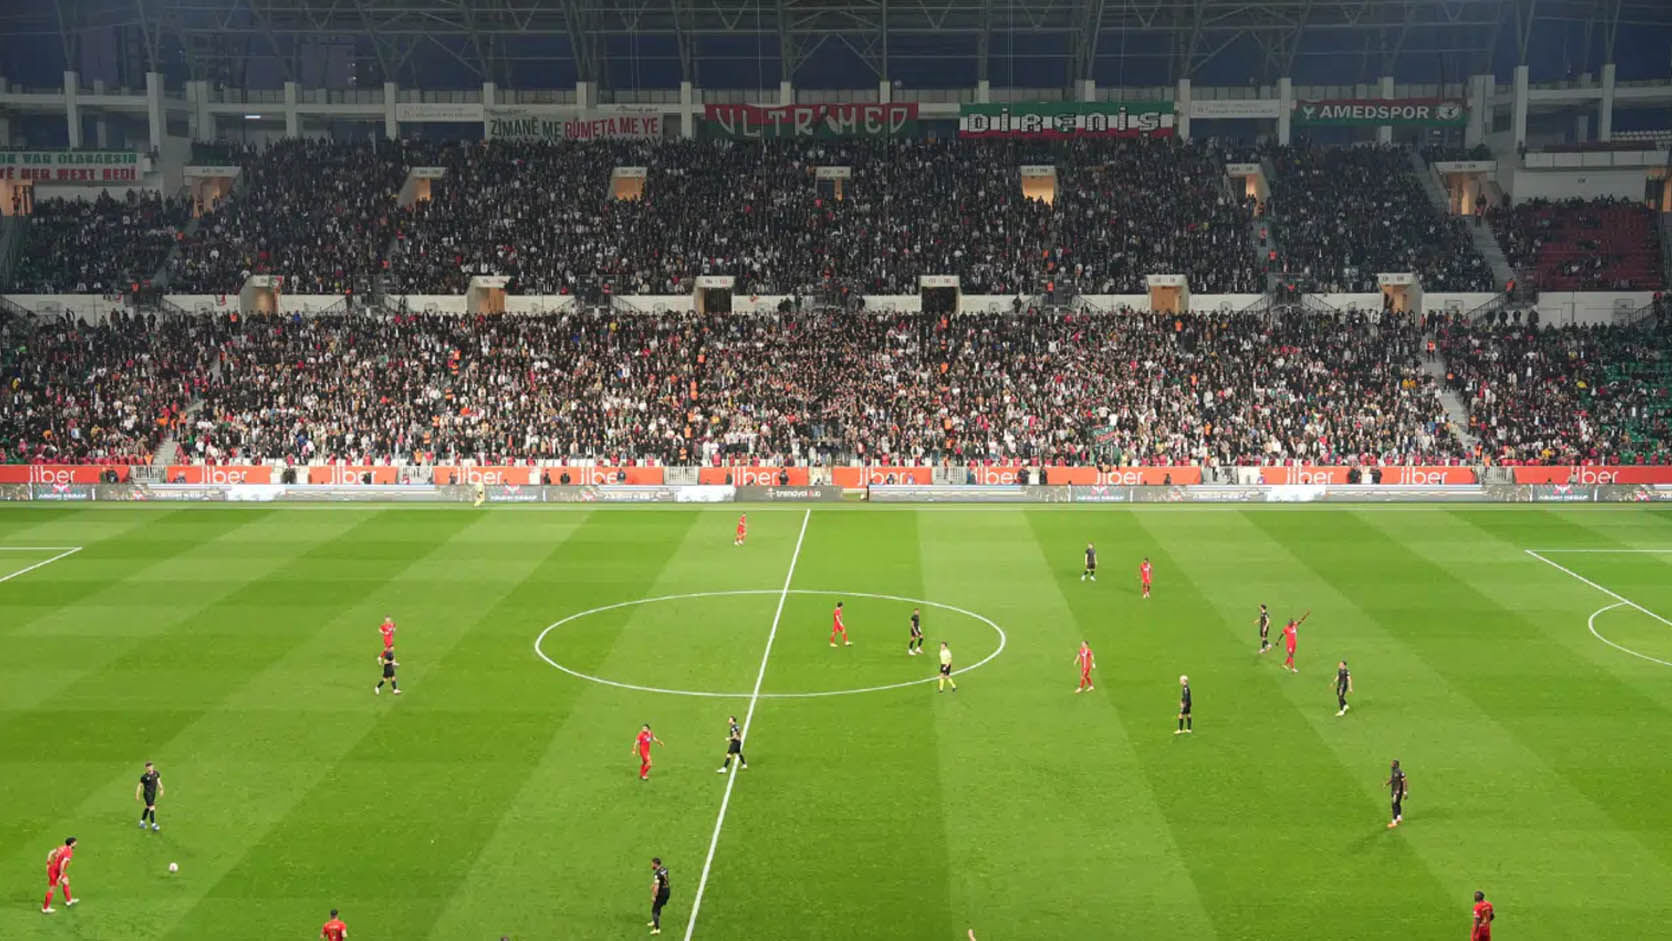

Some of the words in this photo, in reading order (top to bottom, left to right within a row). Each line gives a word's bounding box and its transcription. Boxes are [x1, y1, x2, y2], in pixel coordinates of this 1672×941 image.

[1319, 104, 1430, 120] AMEDSPOR
[542, 119, 562, 137] ME
[619, 116, 639, 134] ME
[642, 116, 658, 134] YE
